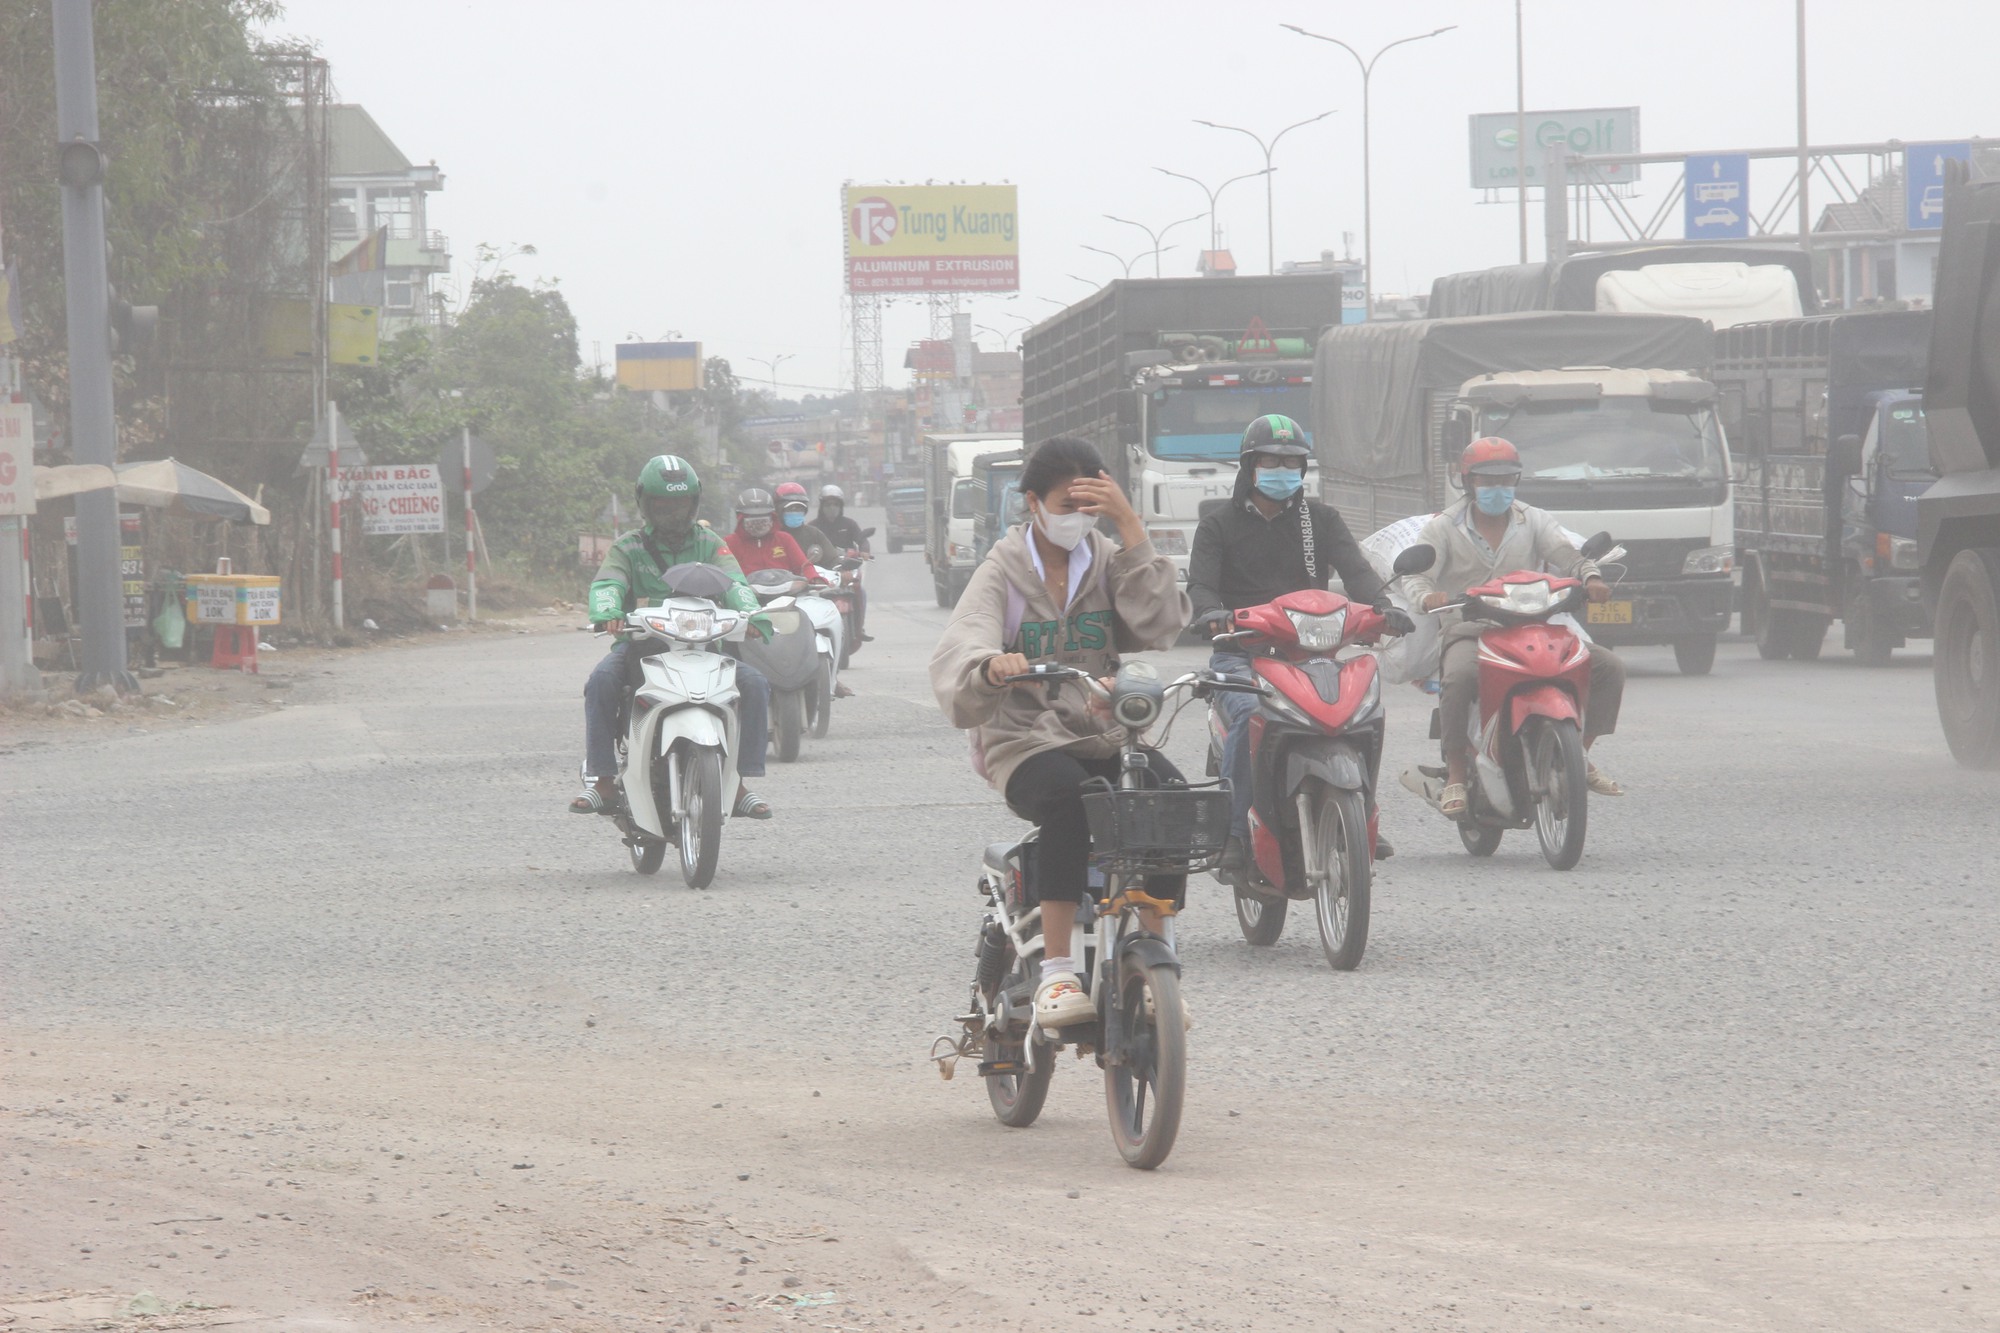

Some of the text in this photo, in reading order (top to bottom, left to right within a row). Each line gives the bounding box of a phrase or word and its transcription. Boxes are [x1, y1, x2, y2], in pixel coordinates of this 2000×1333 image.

[1536, 118, 1615, 153] Golf
[1489, 164, 1536, 179] LONG
[899, 205, 1015, 242] Tung Kuang
[854, 260, 1014, 273] ALUMINUM EXTRUSION
[666, 482, 688, 492] Grab
[205, 607, 225, 618] 10K
[1600, 603, 1619, 612] 51C
[254, 608, 271, 620] 10K
